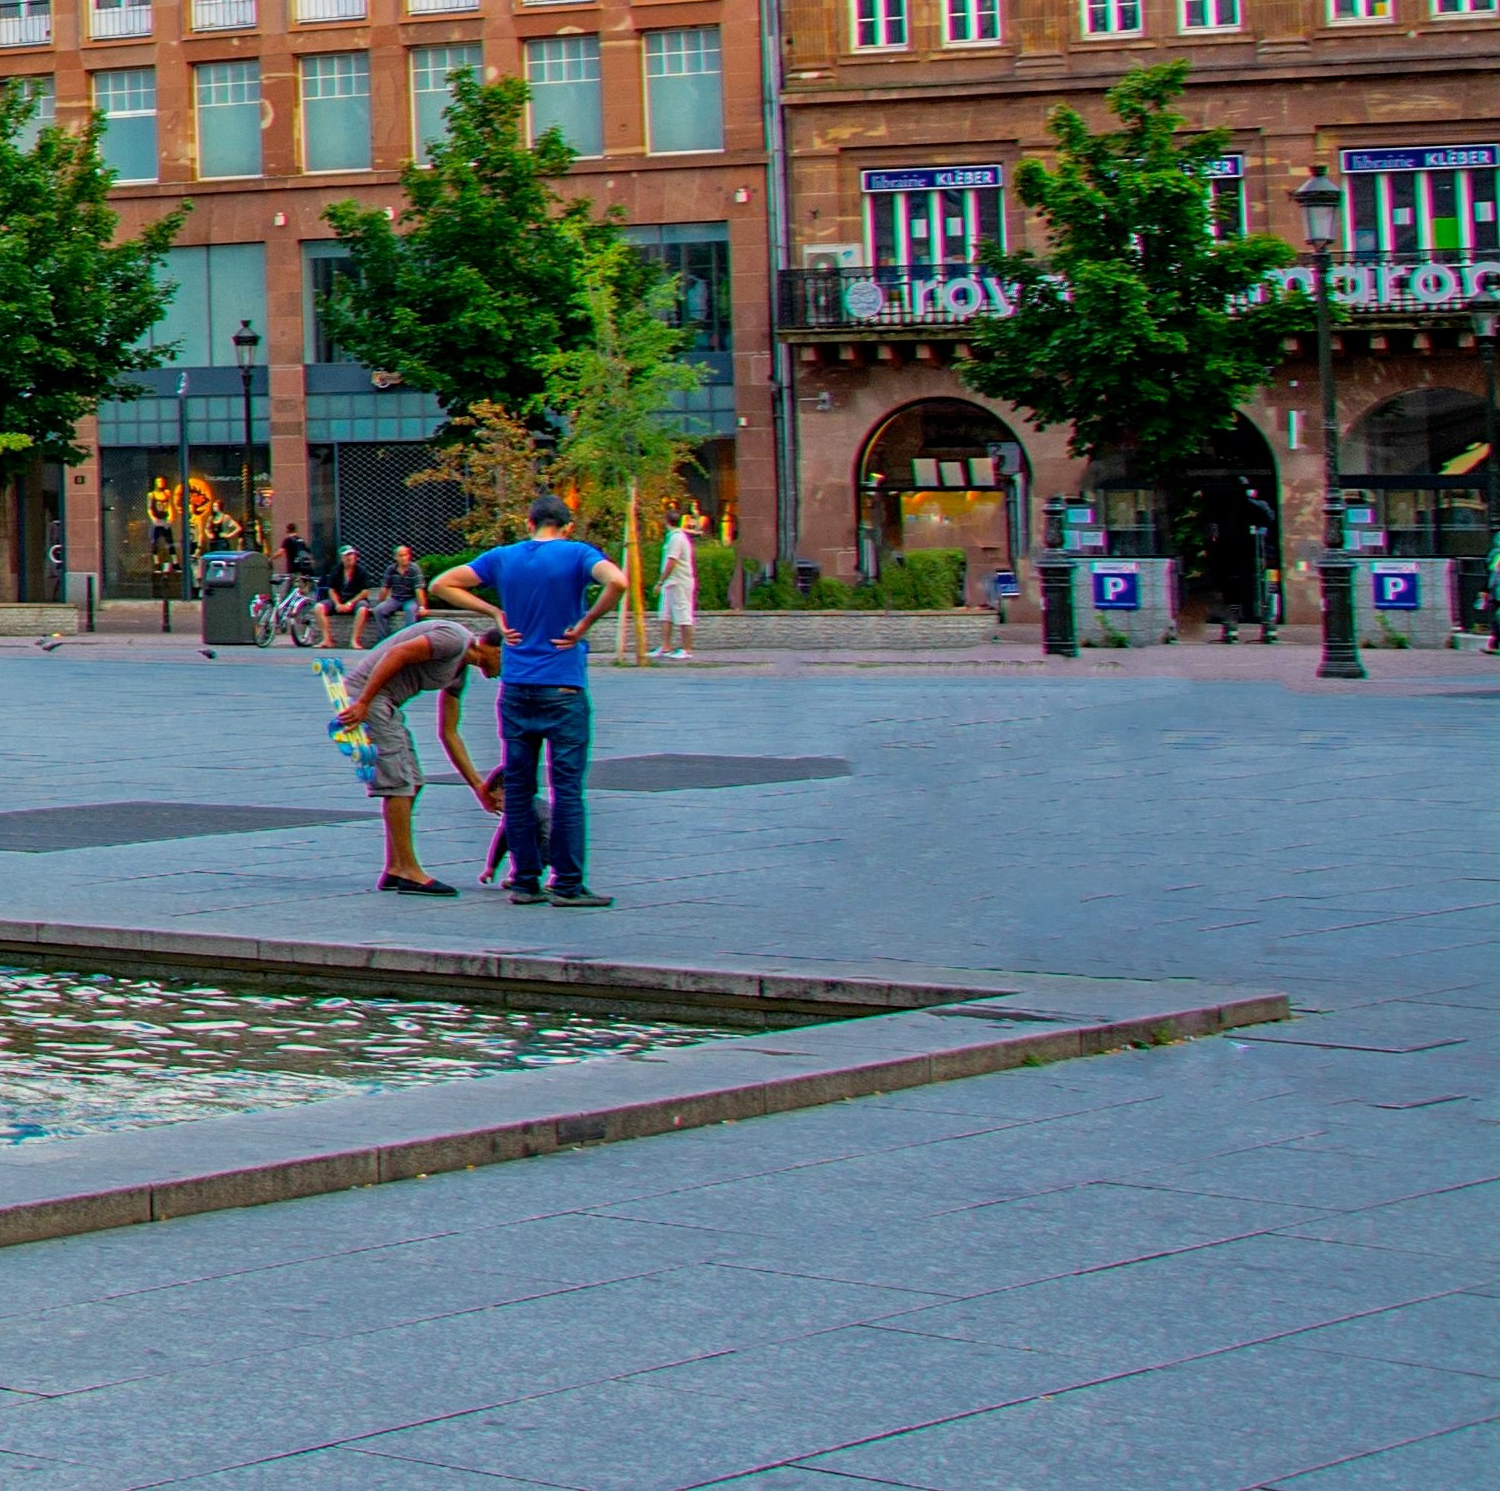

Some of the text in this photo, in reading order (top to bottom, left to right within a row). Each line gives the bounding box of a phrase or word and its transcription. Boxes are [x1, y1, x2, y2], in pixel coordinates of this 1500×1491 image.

[911, 277, 1060, 317] roy
[1104, 576, 1127, 600] P
[1384, 576, 1406, 600] P
